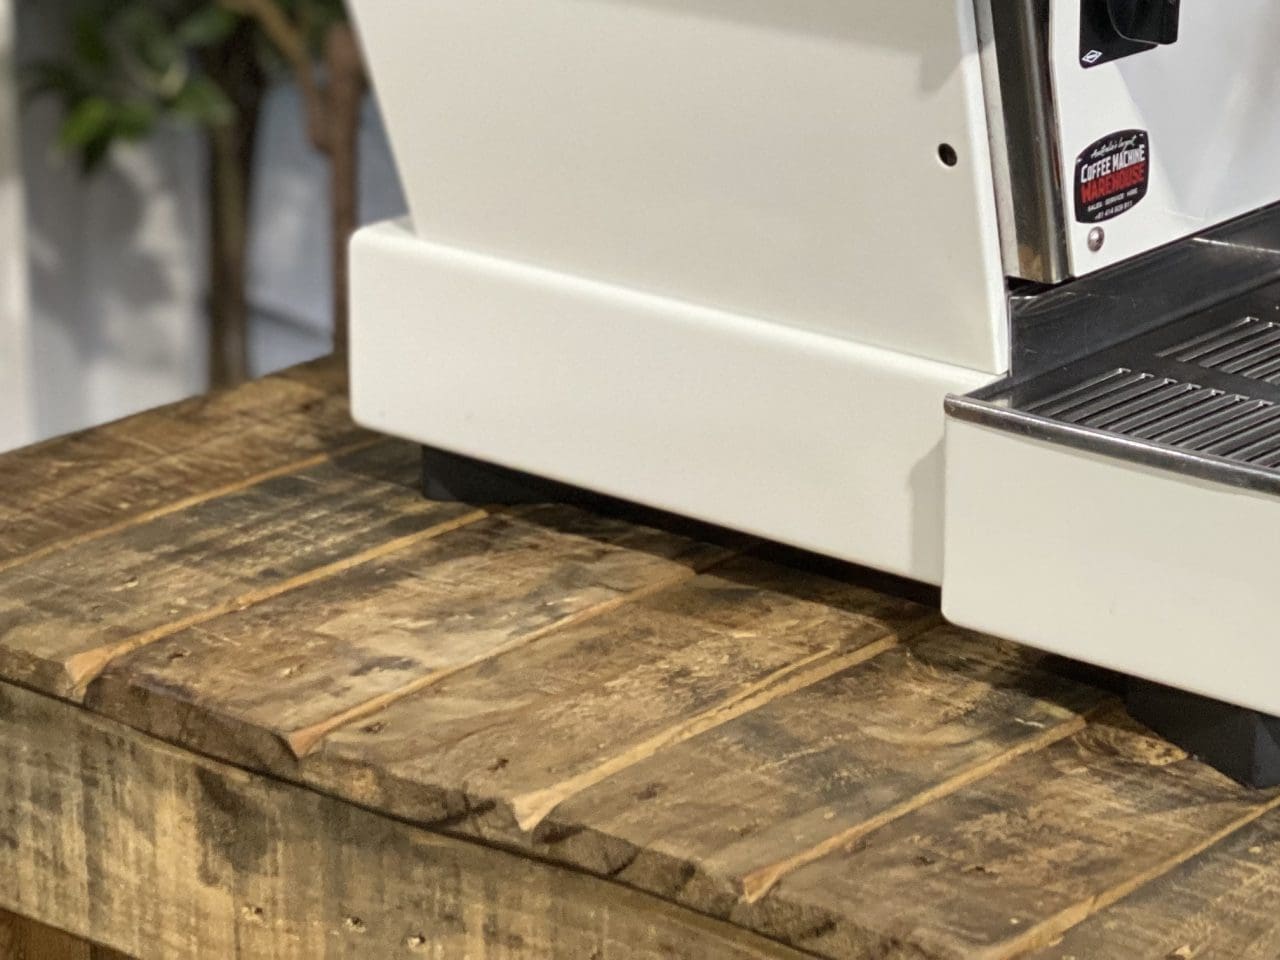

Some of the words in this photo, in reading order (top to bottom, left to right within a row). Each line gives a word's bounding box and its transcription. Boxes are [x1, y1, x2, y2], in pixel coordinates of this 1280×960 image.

[1080, 156, 1111, 183] COFFEE
[1112, 144, 1145, 172] MACHINE
[1081, 162, 1145, 204] WAREHOUSE
